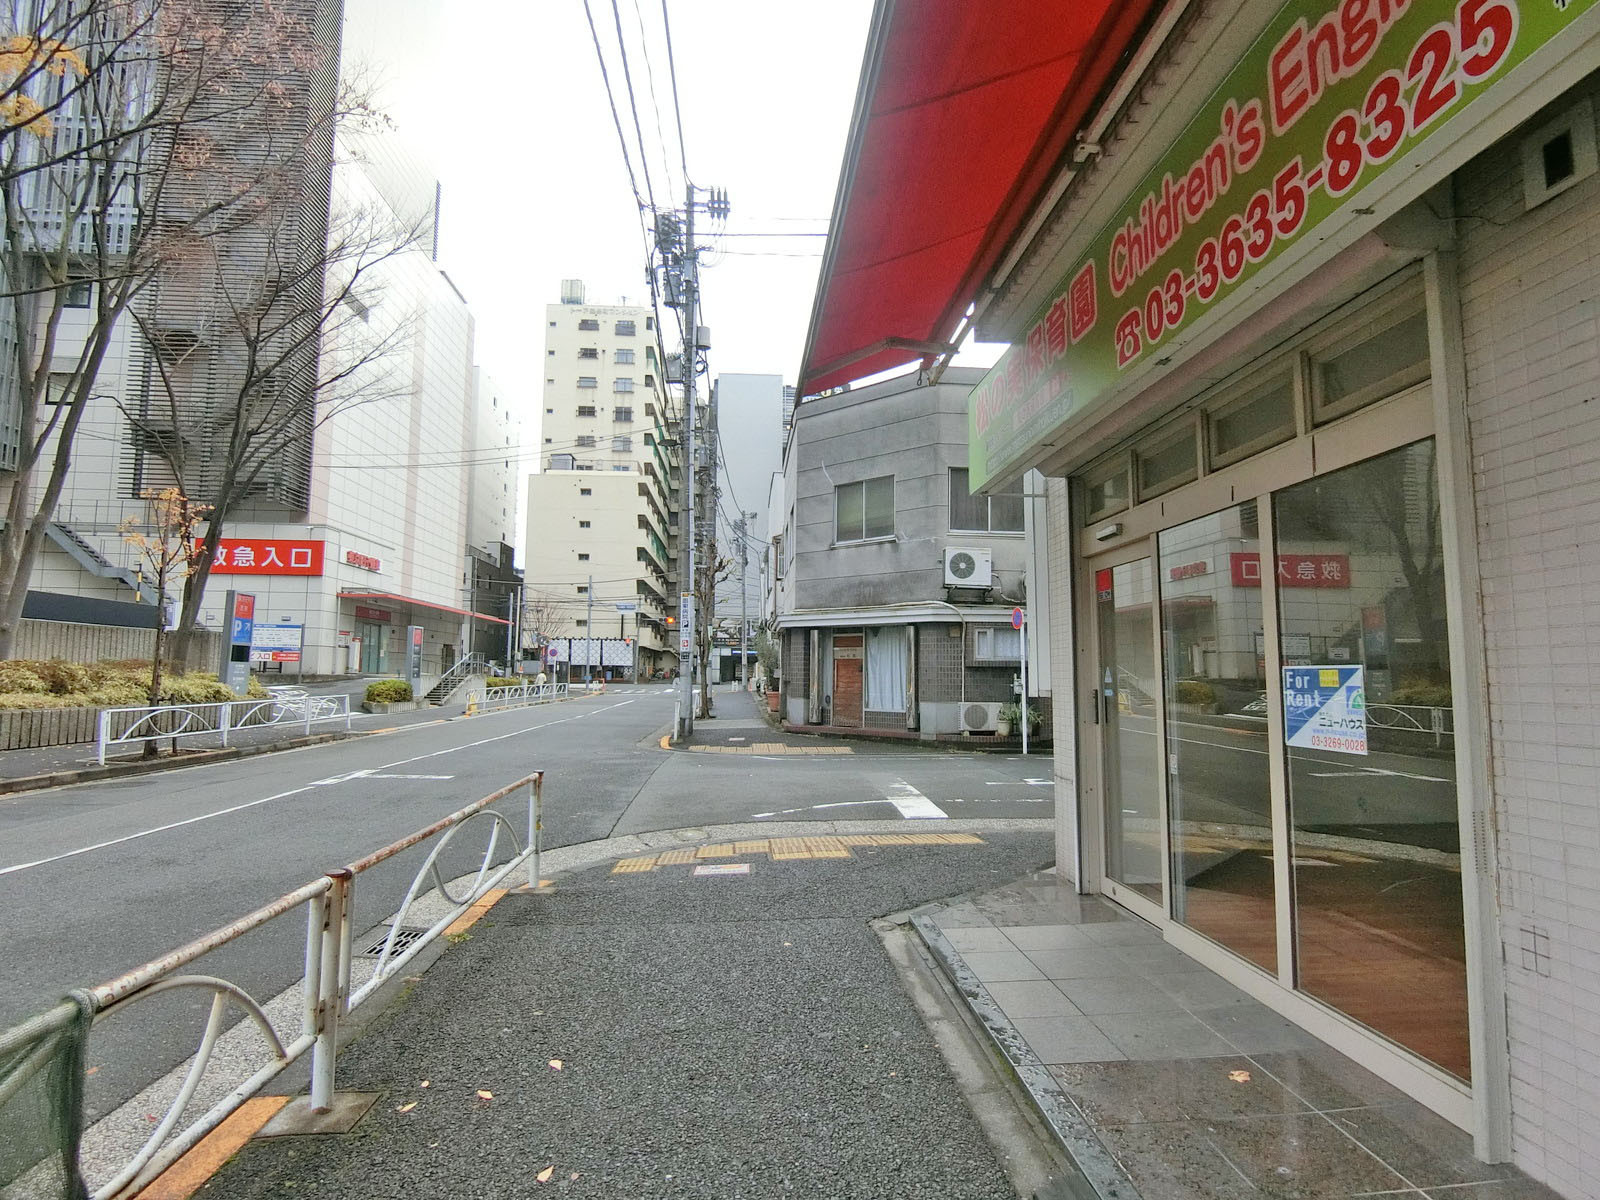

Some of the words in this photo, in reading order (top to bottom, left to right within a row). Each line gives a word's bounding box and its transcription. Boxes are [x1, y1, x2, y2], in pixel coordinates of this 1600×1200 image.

[1111, 106, 1262, 287] Children's
[1271, 0, 1407, 128] Eng
[1145, 0, 1513, 337] 03-3635-8325
[1286, 671, 1310, 689] For
[1286, 689, 1320, 707] Rent
[1319, 717, 1364, 730] ニューハウス
[1312, 735, 1366, 751] 03-3269-0028
